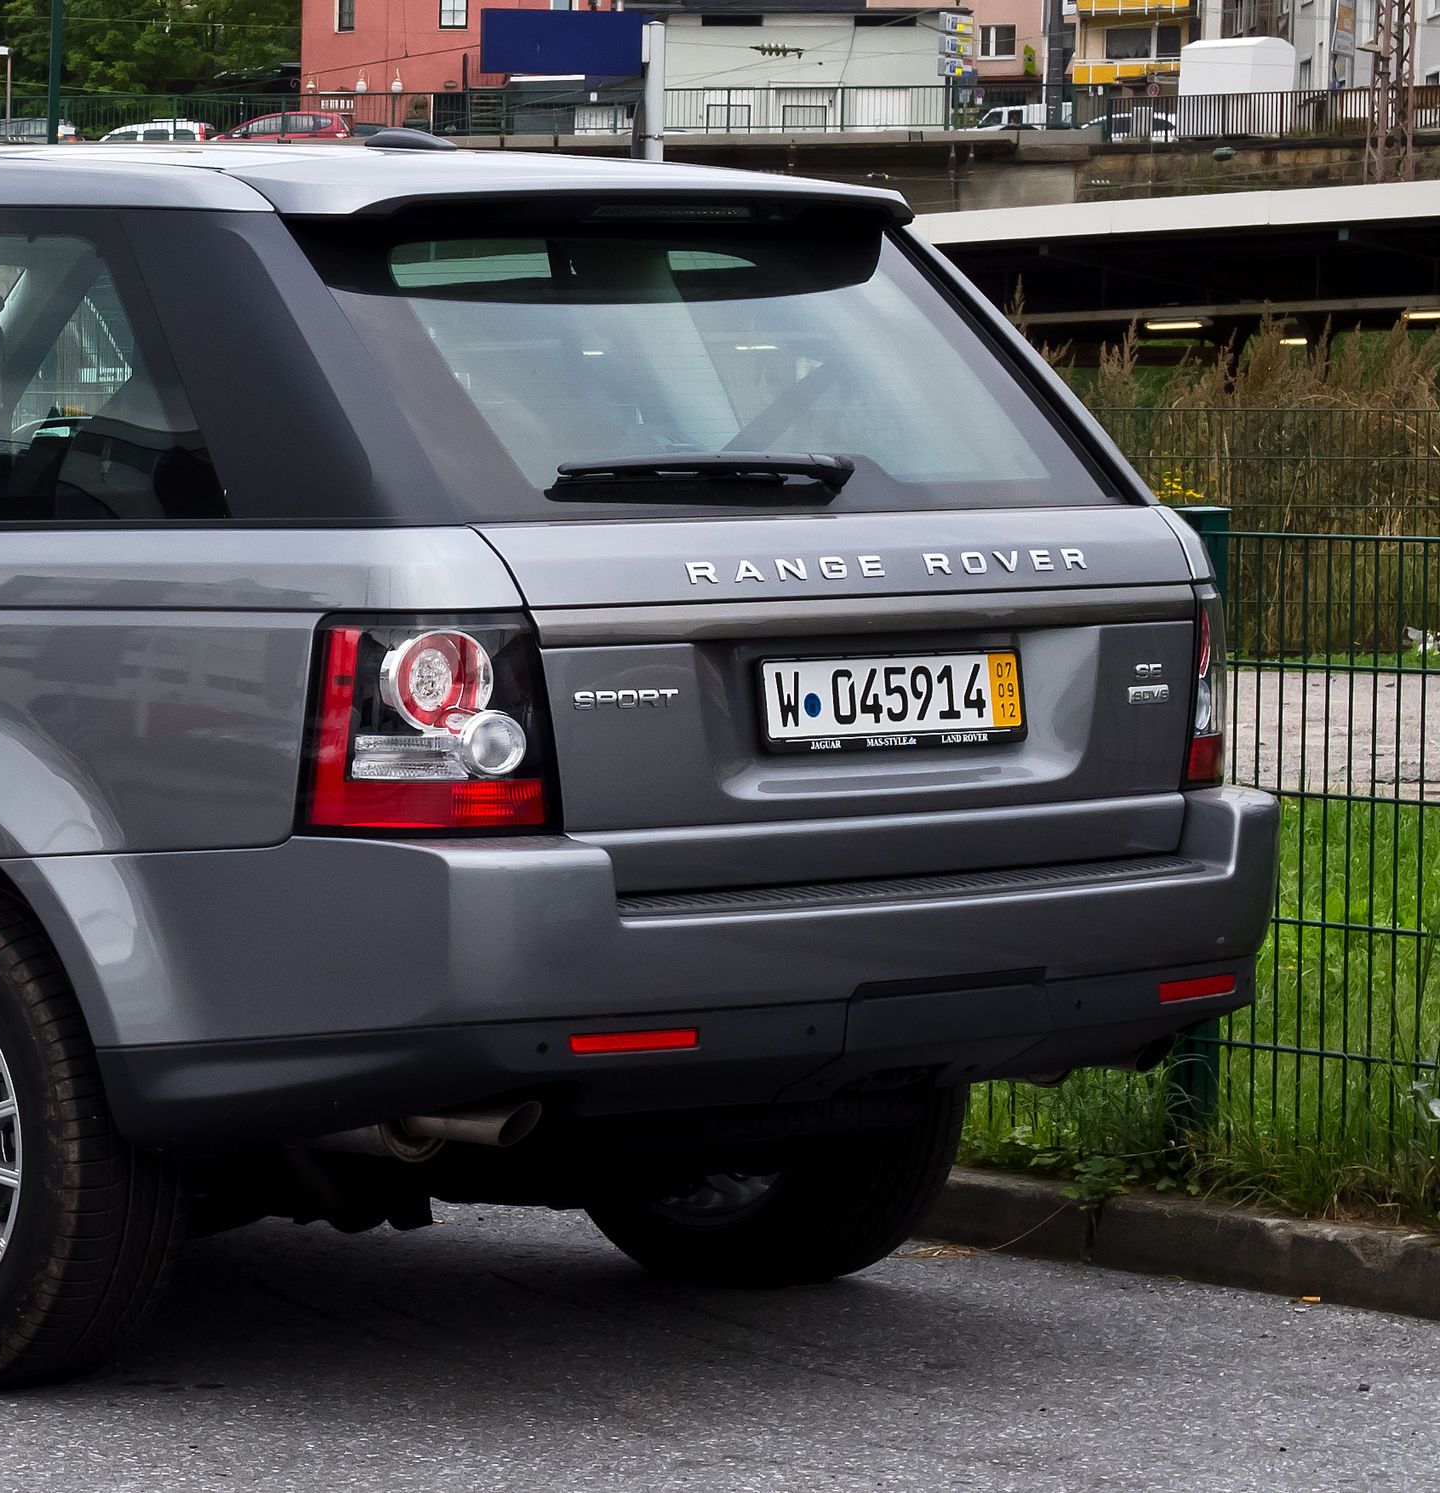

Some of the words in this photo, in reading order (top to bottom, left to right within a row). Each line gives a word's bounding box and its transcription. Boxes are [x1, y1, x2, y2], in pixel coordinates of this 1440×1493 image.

[685, 555, 885, 584] RANGE
[922, 549, 1087, 575] ROVER
[996, 662, 1012, 678] 07
[1135, 663, 1162, 679] SE
[775, 671, 799, 727] W
[831, 663, 986, 725] 045914
[998, 682, 1014, 698] 09
[574, 688, 679, 710] SPORT
[1001, 702, 1016, 718] 12
[810, 740, 841, 750] JAGUAR
[941, 734, 962, 744] LAND
[962, 733, 988, 743] ROVER
